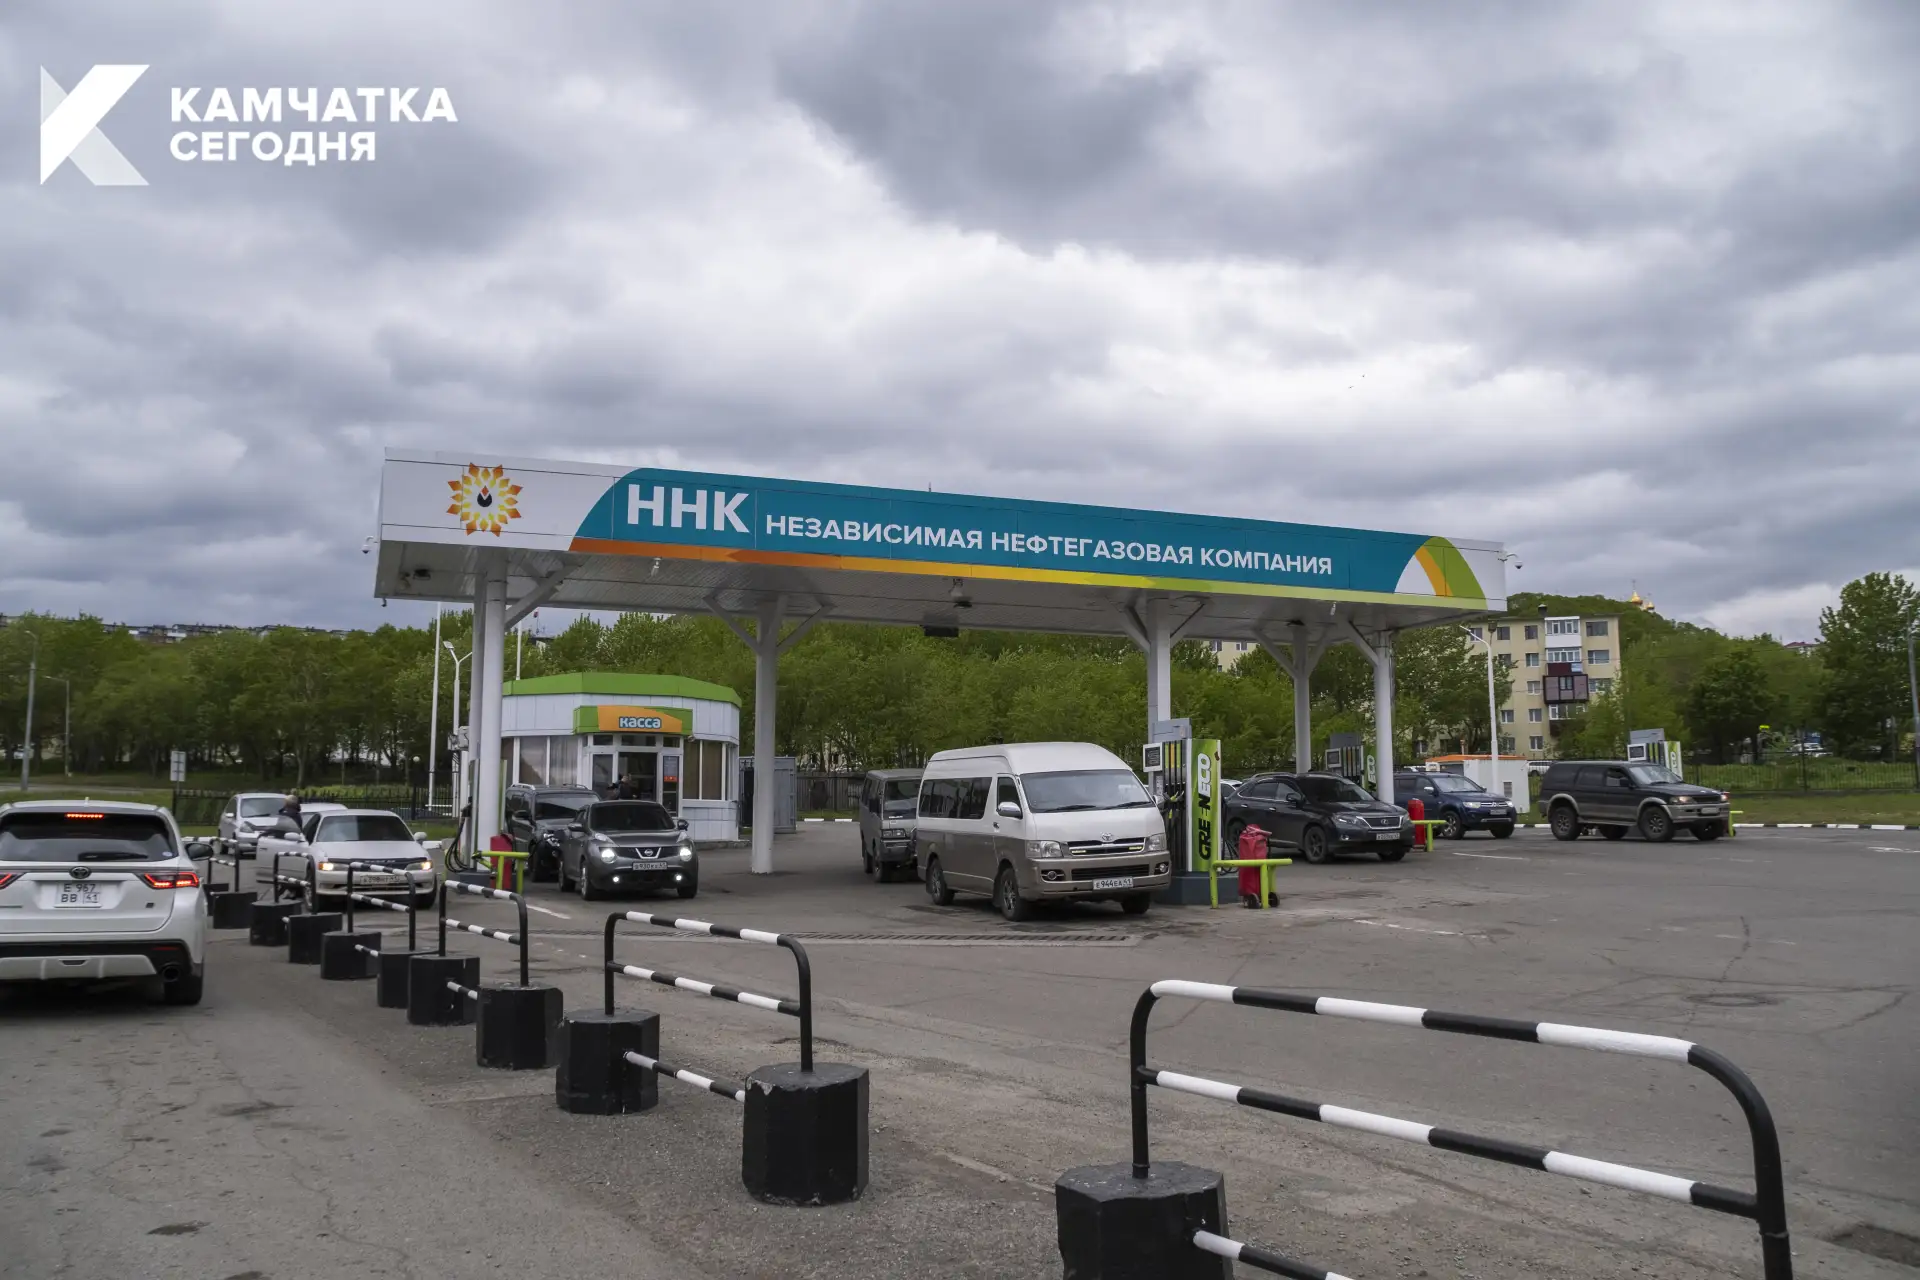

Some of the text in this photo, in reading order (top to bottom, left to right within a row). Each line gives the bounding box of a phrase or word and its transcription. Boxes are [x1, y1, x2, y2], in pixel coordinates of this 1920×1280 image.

[627, 483, 750, 534] ННК
[766, 514, 1332, 575] НЕЗАВИСИМАЯ НЕФТЕГАЗОВАЯ КОМПАНИЯ
